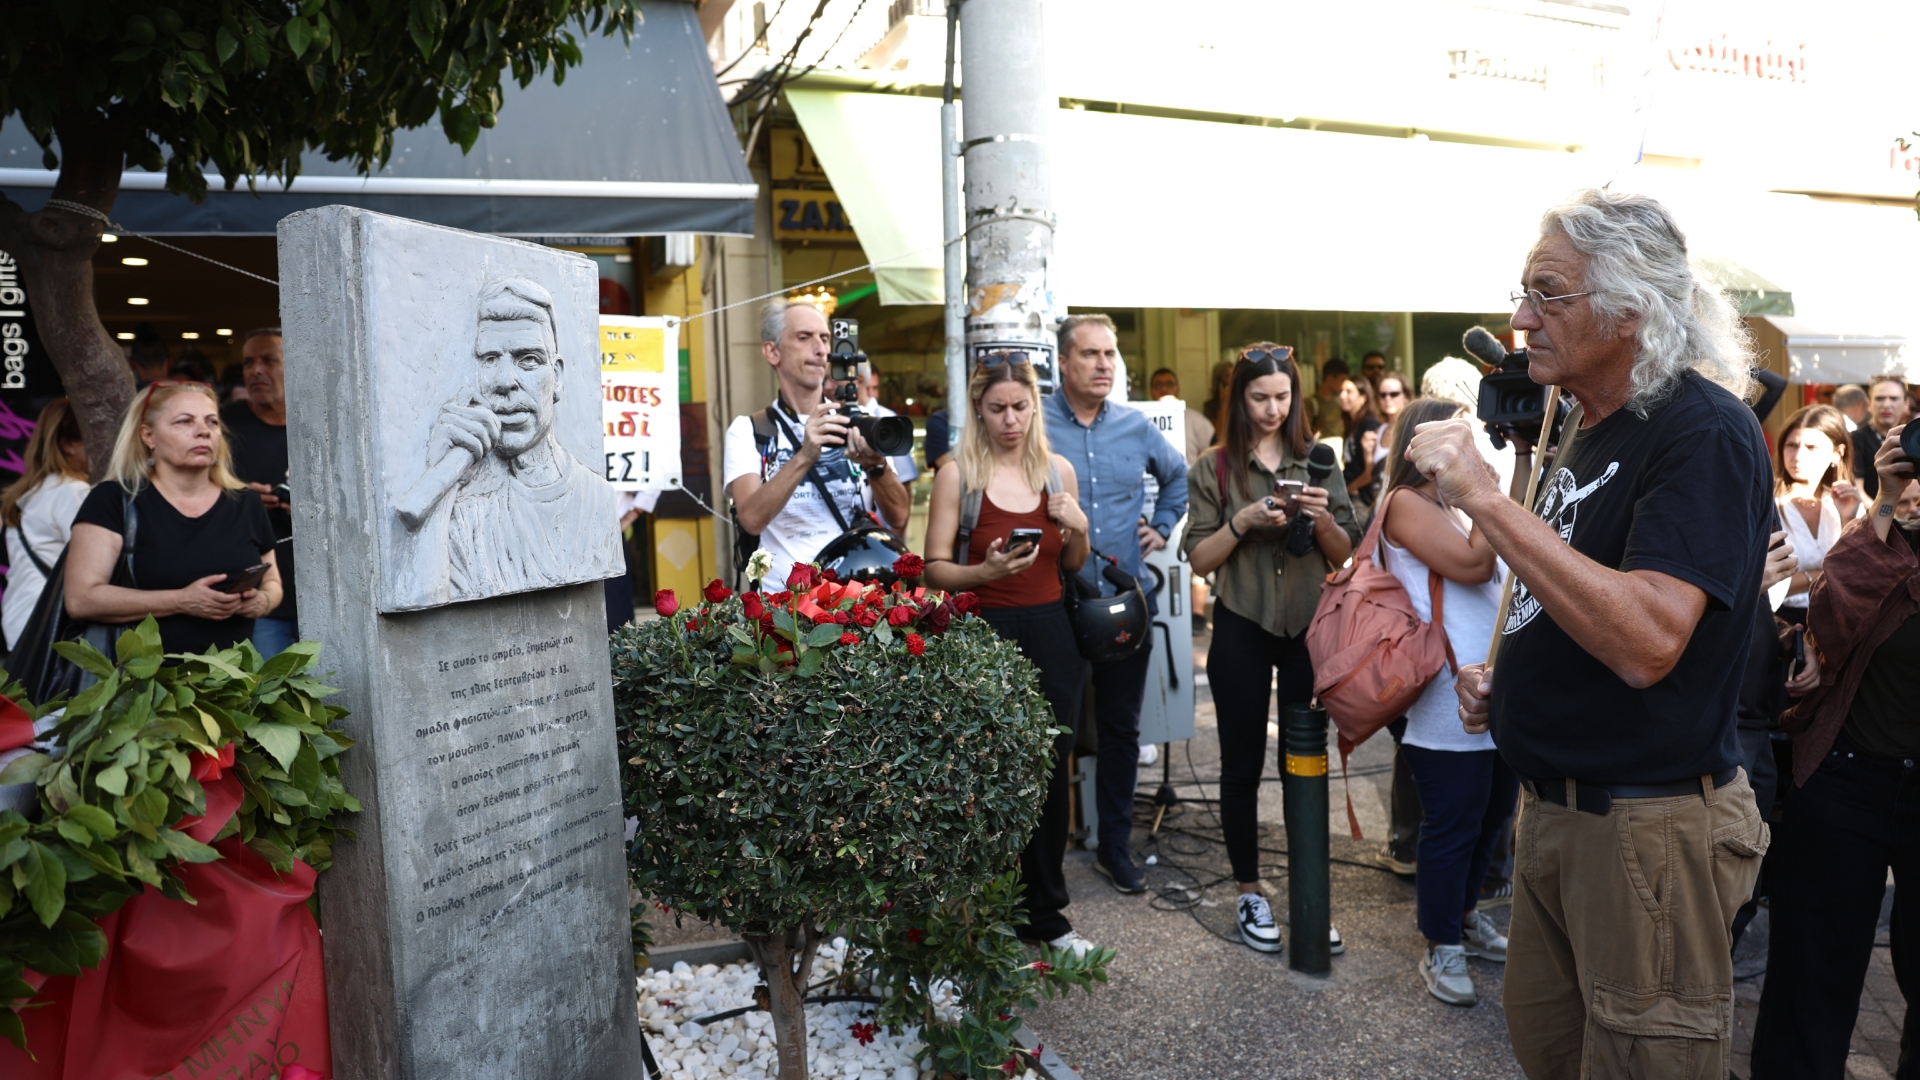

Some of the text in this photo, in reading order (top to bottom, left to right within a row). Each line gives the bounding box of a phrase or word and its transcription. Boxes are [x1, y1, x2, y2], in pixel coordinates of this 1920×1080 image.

[779, 199, 853, 231] ΖΑΧ
[1, 322, 29, 389] bags
[603, 411, 651, 437] ιδί
[438, 660, 449, 673] Σε
[479, 652, 489, 663] το
[450, 688, 467, 700] της
[427, 753, 446, 766] τον
[427, 897, 466, 919] Παύλος
[507, 870, 525, 886] από
